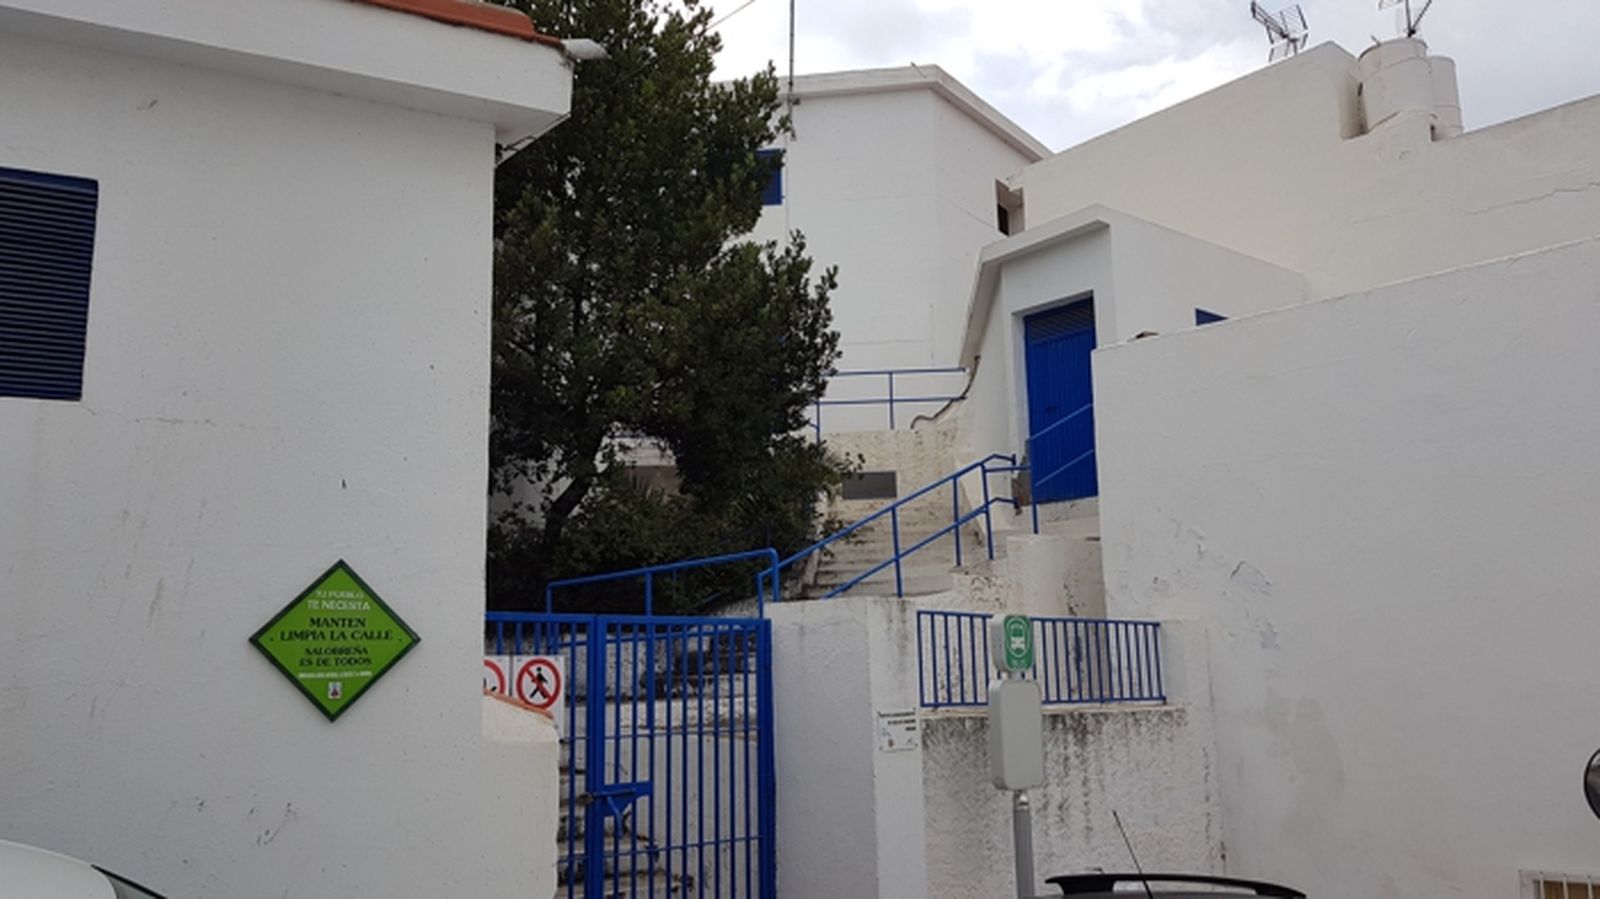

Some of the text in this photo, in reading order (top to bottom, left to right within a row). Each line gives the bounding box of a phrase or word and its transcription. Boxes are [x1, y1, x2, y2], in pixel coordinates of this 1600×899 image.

[309, 617, 366, 628] MANTEN
[280, 629, 393, 640] LIMPIA LA CALLE
